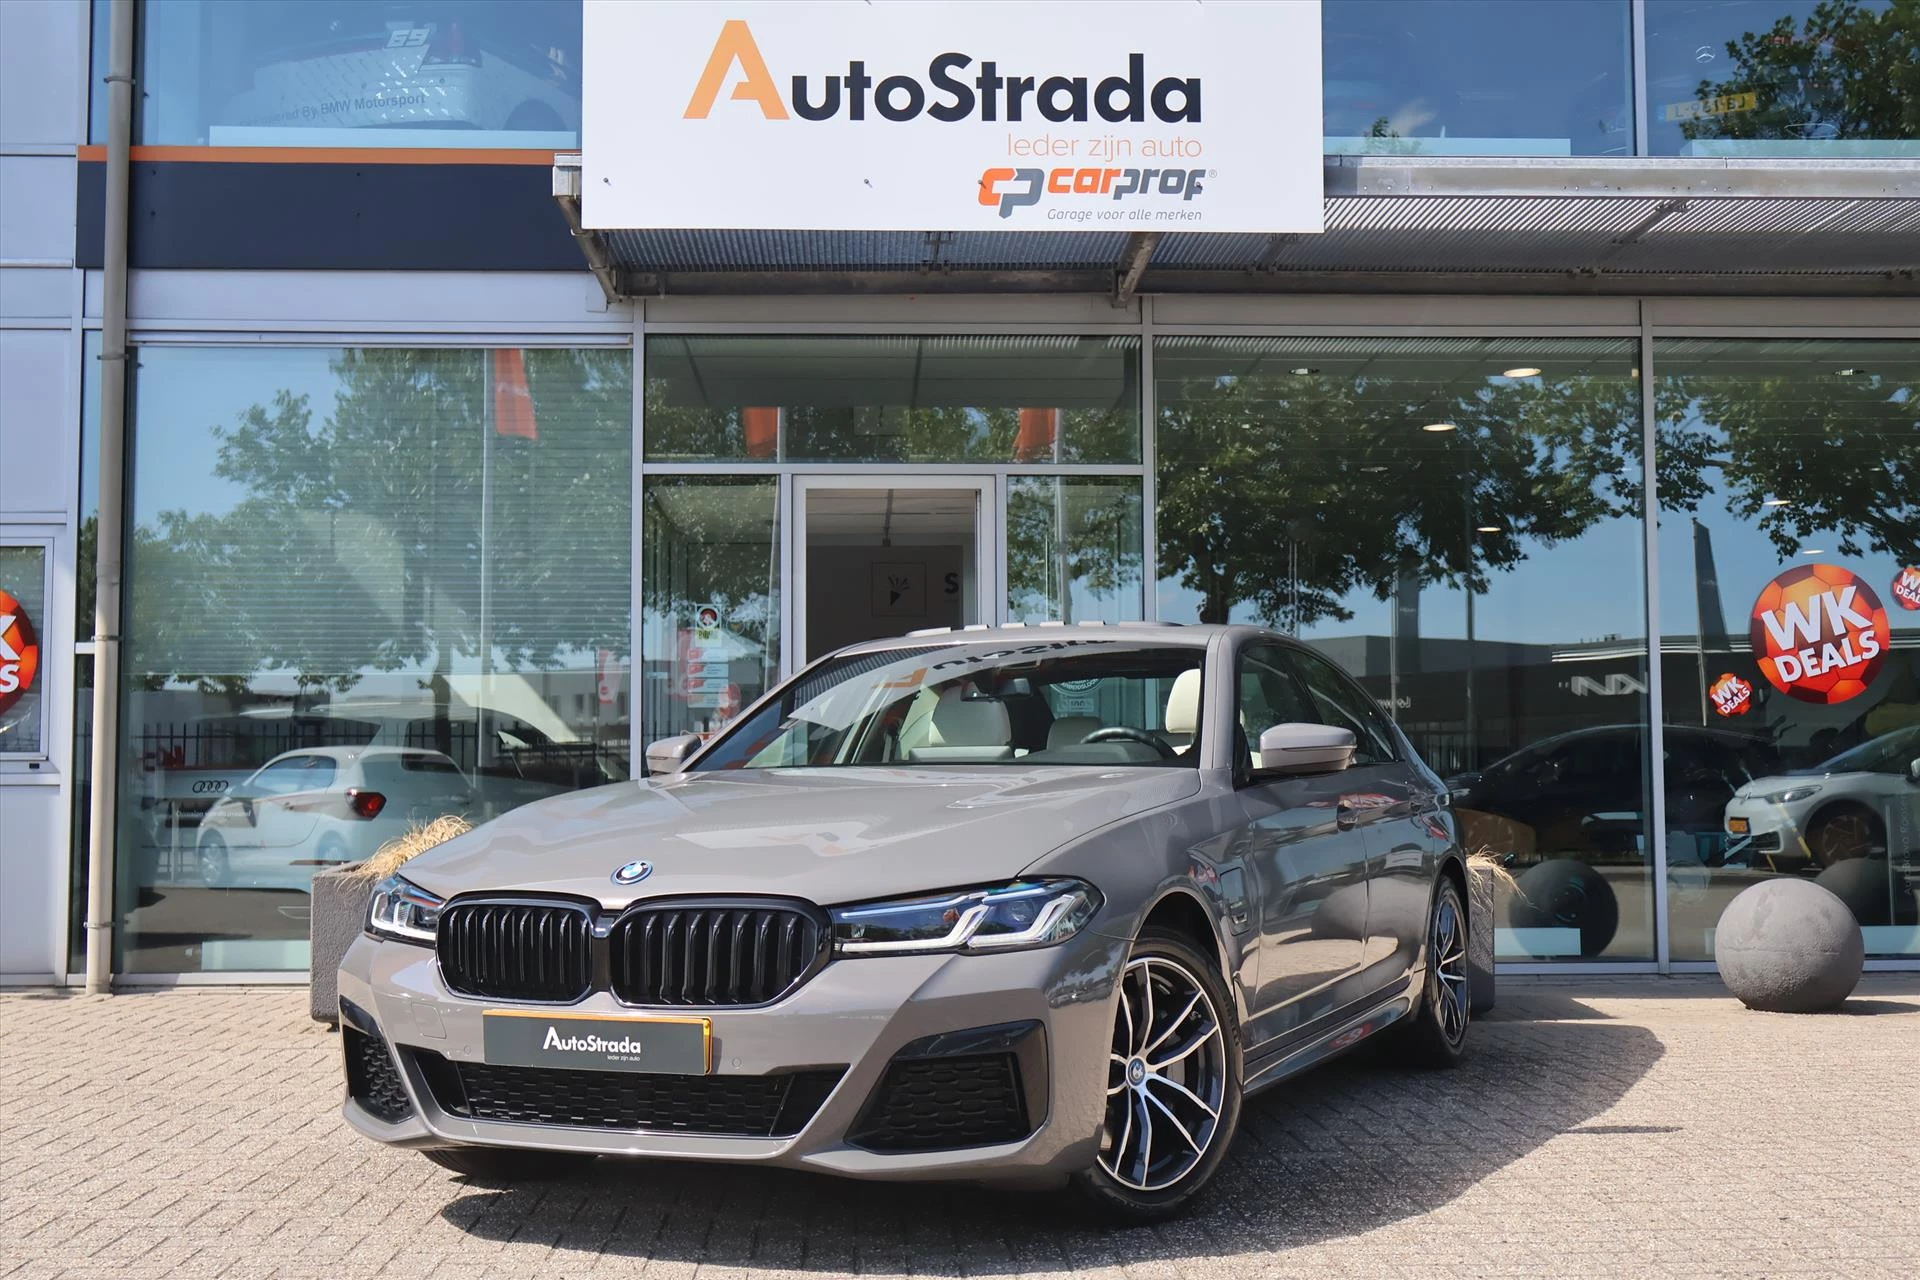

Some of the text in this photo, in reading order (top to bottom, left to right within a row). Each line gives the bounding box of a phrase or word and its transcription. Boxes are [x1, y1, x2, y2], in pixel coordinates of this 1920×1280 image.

[683, 19, 1201, 123] AutoStrada
[321, 100, 350, 114] BMW
[355, 94, 425, 112] Motorsport
[1008, 133, 1202, 162] Ieder zijn auto
[1047, 209, 1202, 222] Garage voor alle merken
[1761, 585, 1872, 651] WK
[1774, 631, 1879, 683] DEALS
[1711, 676, 1745, 705] WK
[1720, 687, 1750, 714] DEALS
[543, 1026, 641, 1053] AutoStrada
